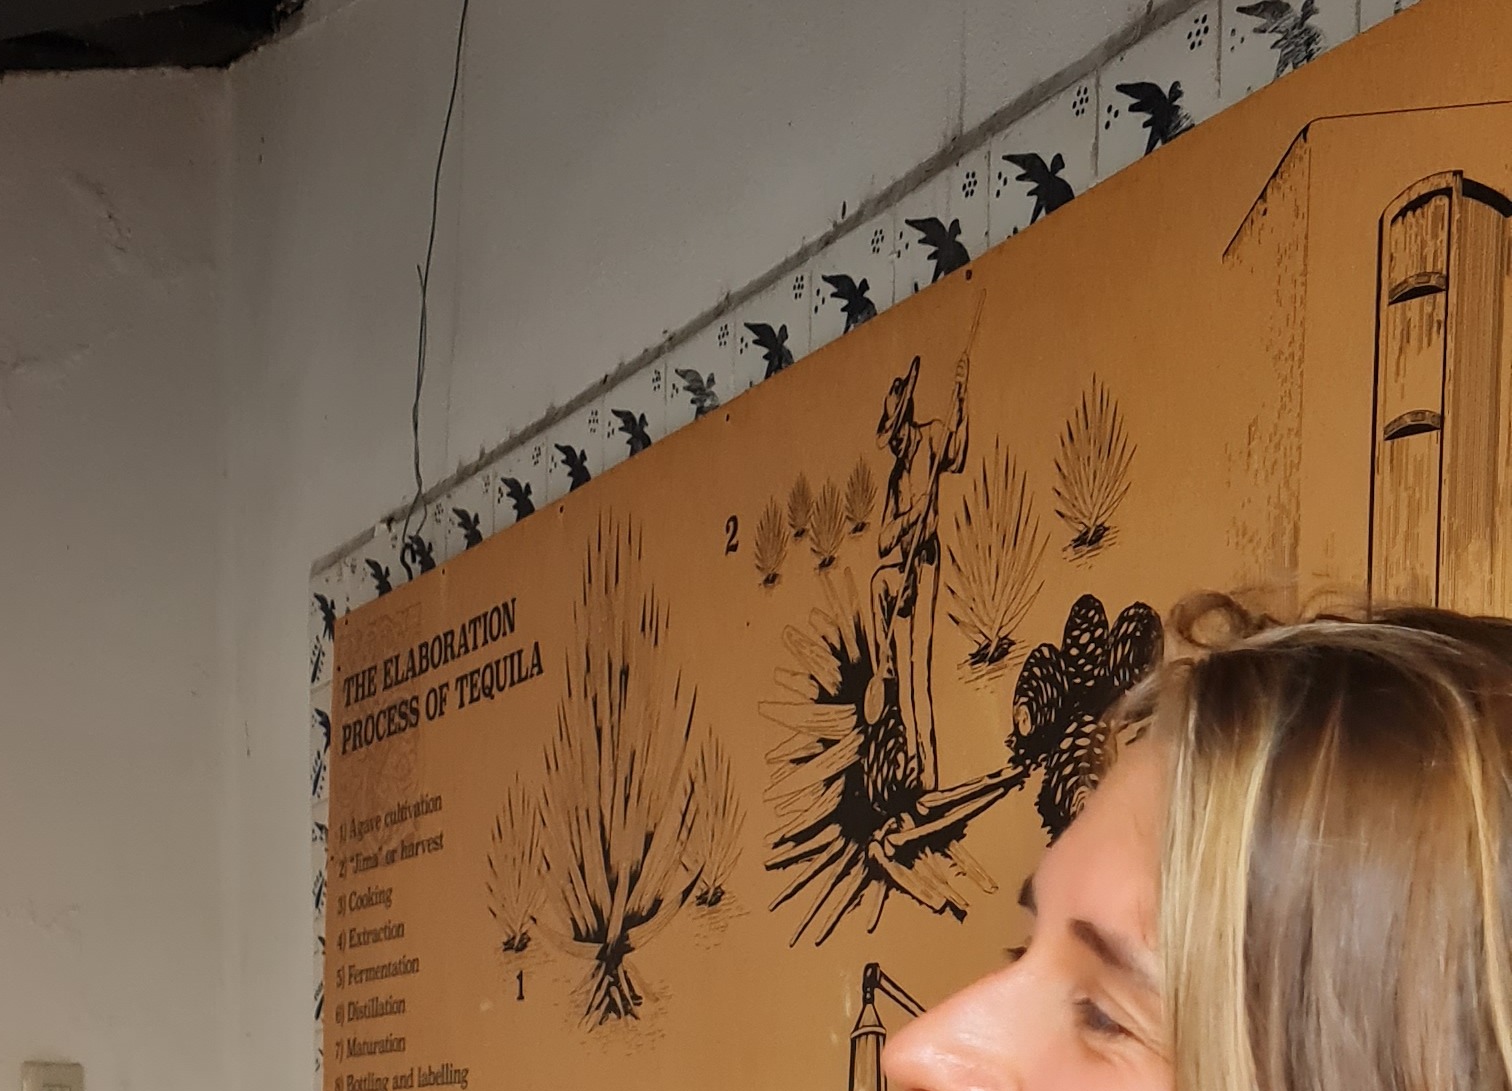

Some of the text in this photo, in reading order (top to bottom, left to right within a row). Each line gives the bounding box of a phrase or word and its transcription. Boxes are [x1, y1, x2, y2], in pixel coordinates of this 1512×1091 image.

[725, 514, 739, 556] 2
[343, 598, 517, 708] THE ELABORATION
[341, 641, 544, 755] PROCESS OF TEQUILA
[349, 814, 382, 841] Agave
[384, 793, 443, 827] cultivation
[401, 830, 444, 861] harvest
[349, 885, 393, 912] Cooking
[349, 921, 405, 948] Extraction
[348, 955, 420, 986] Fermentation
[516, 970, 525, 1001] 1
[347, 995, 405, 1022] Distillation
[347, 1033, 406, 1058] Maturation
[392, 1067, 414, 1091] and
[418, 1063, 470, 1090] labelling
